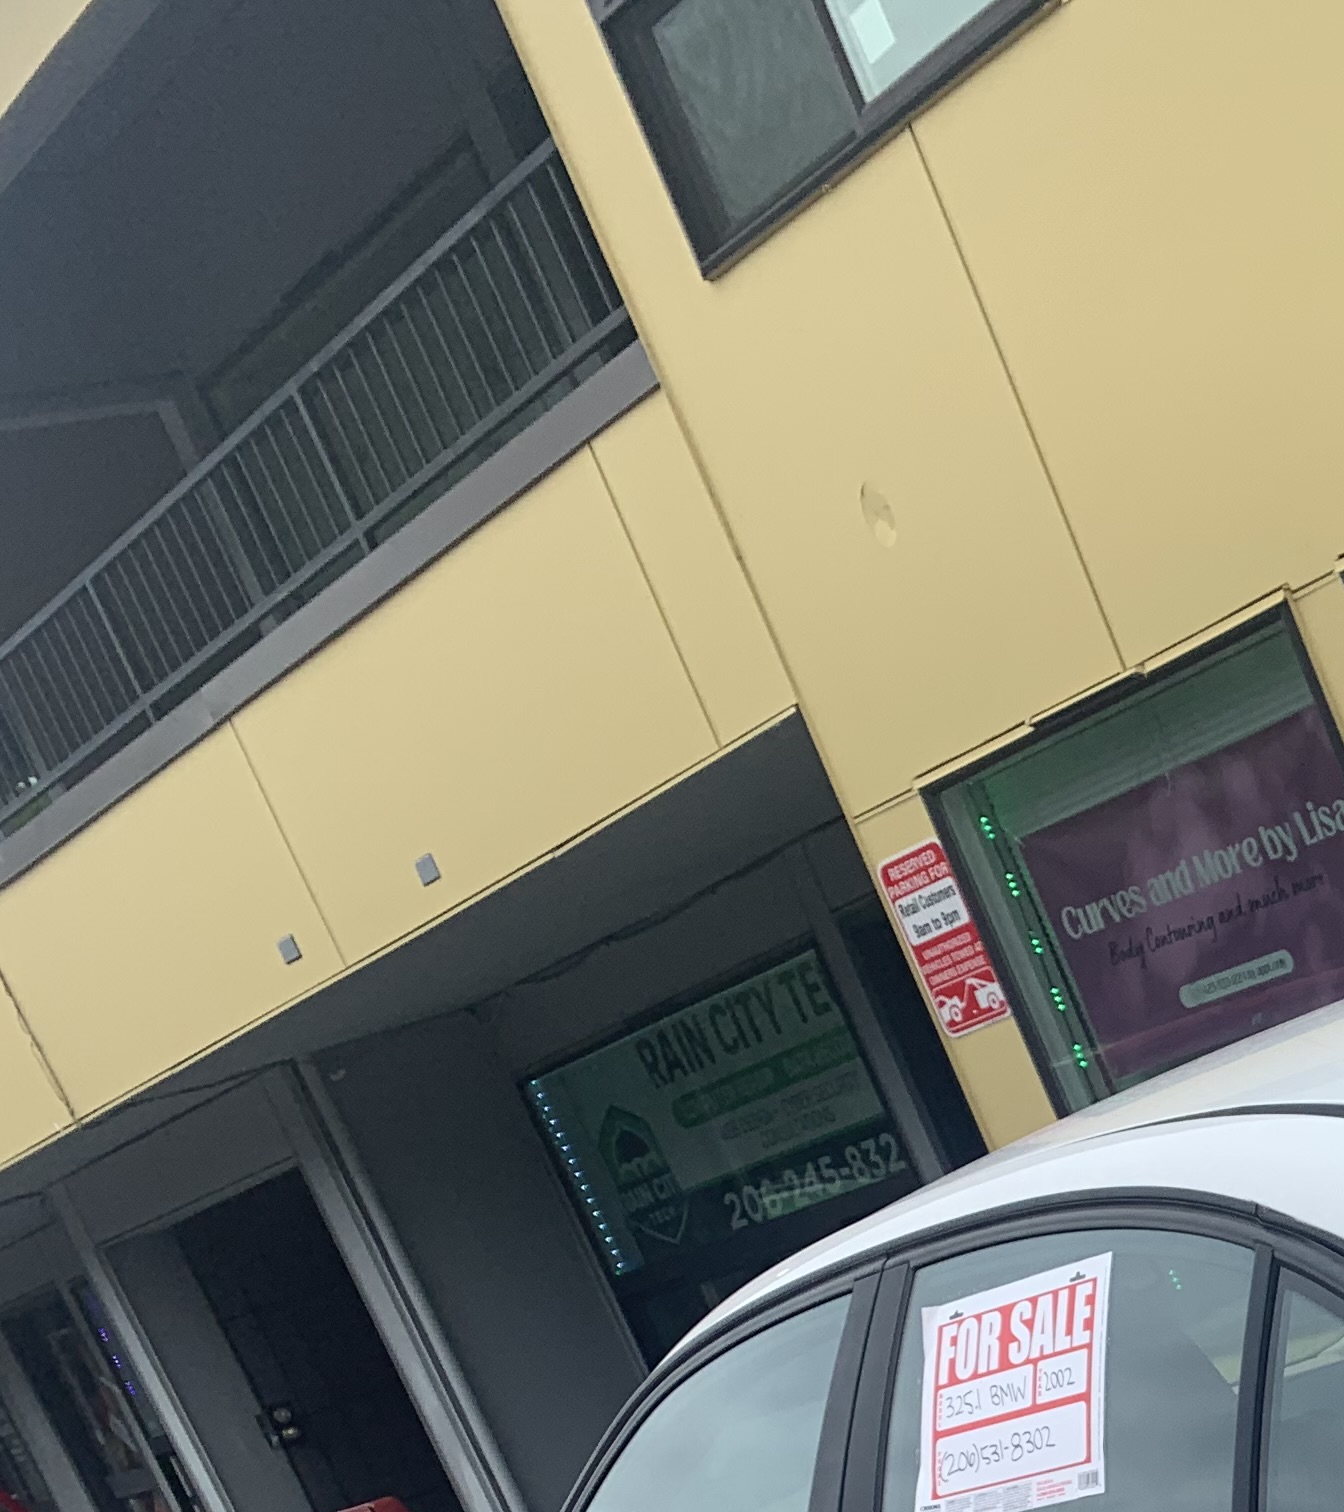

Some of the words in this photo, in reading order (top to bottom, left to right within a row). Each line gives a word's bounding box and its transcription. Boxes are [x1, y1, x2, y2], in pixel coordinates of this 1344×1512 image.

[887, 873, 930, 898] PARKING
[929, 862, 949, 881] FOR
[888, 849, 937, 881] RESERVED
[1061, 884, 1147, 940] Curves
[1148, 860, 1191, 905] and
[1194, 842, 1261, 888] More
[1260, 822, 1299, 863] by
[898, 896, 920, 919] Retail
[918, 884, 957, 912] Customers
[912, 920, 933, 939] 9am
[934, 916, 945, 931] to
[1108, 939, 1148, 969] Body
[1146, 909, 1217, 953] Contouring
[1218, 901, 1243, 928] and
[1248, 876, 1290, 916] much
[636, 1014, 719, 1089] RAIN
[709, 982, 785, 1056] CITY
[938, 1310, 1000, 1386] FOR
[1008, 1281, 1093, 1365] SALE
[990, 1375, 1028, 1407] BMW
[1044, 1367, 1076, 1392] 2002
